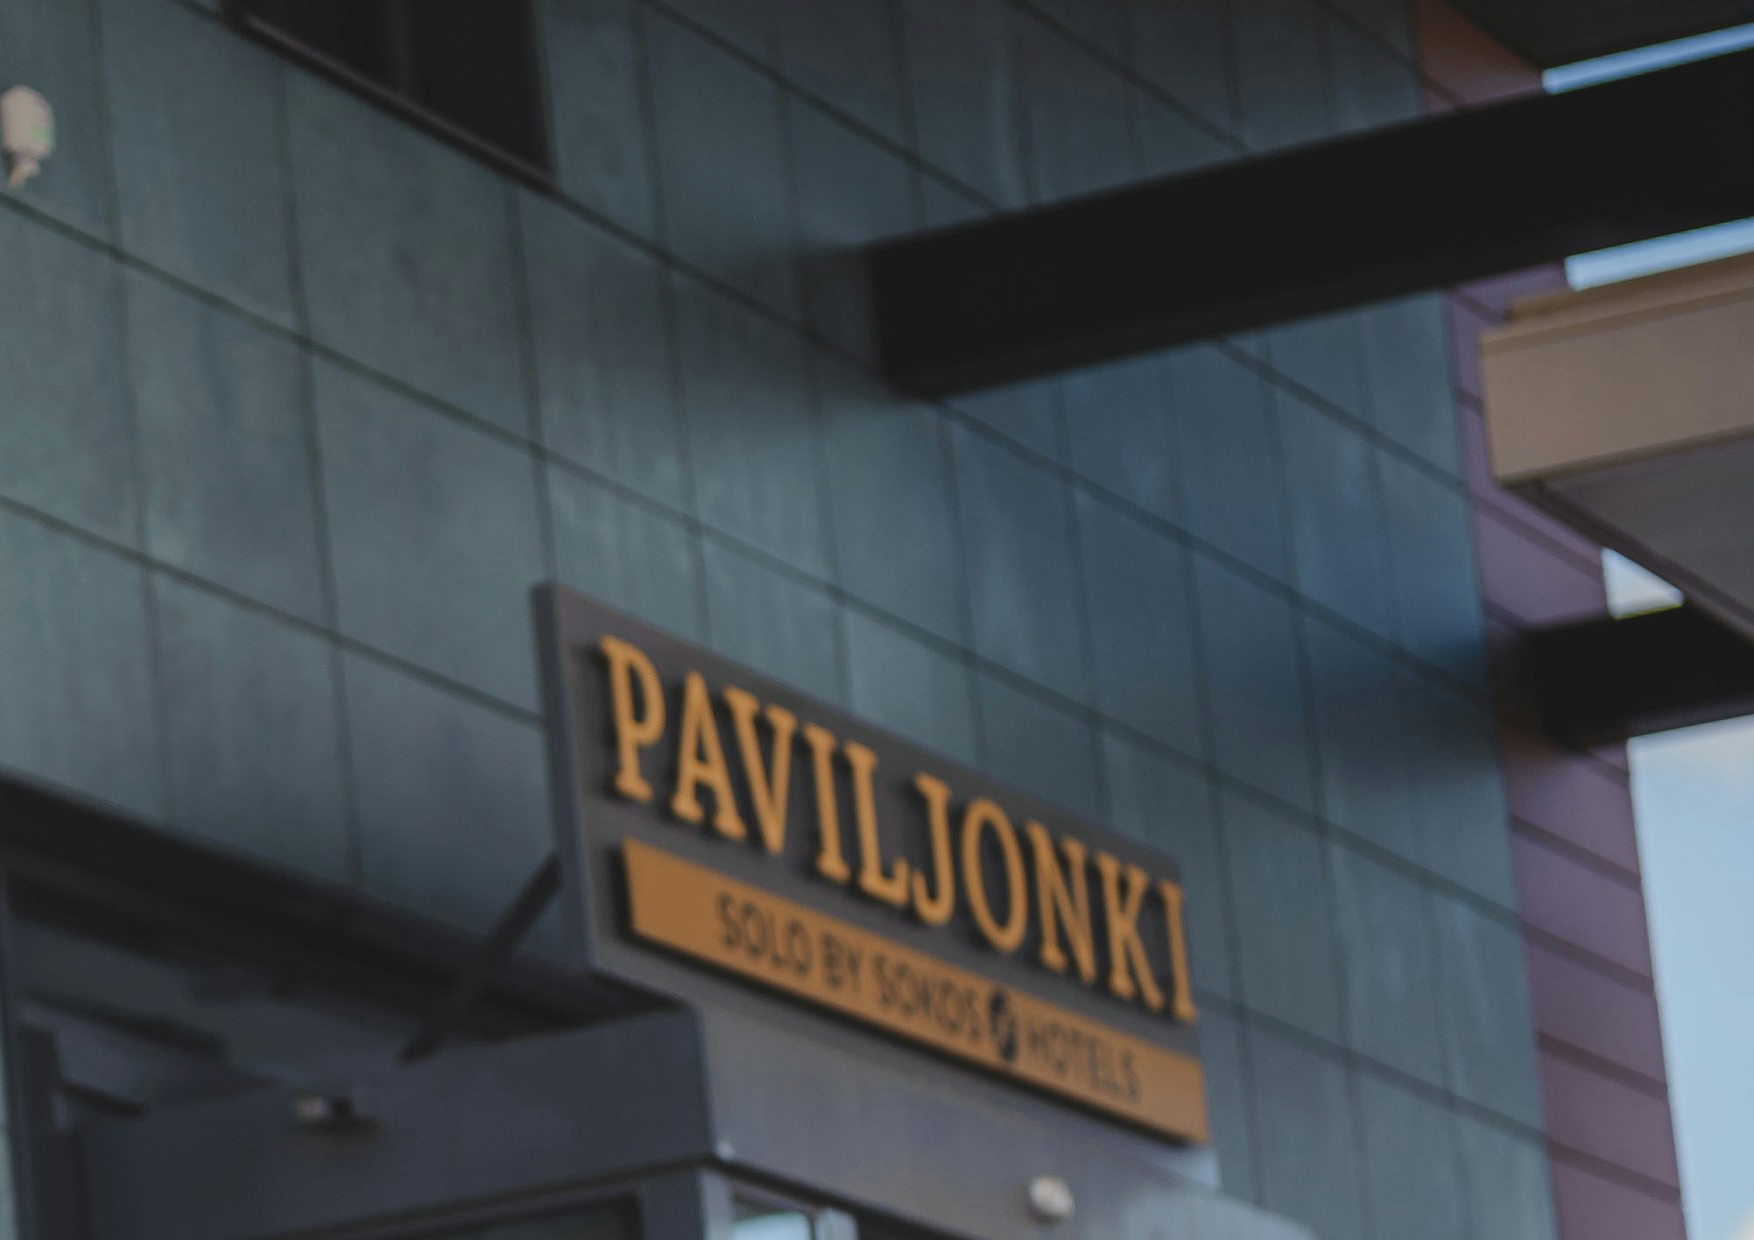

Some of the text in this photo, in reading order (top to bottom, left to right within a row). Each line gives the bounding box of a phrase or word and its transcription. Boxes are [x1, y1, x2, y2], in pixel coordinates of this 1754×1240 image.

[601, 634, 1199, 1024] PAVILJONKI
[716, 893, 1143, 1103] SOLO BY SOKOS HOTELS
